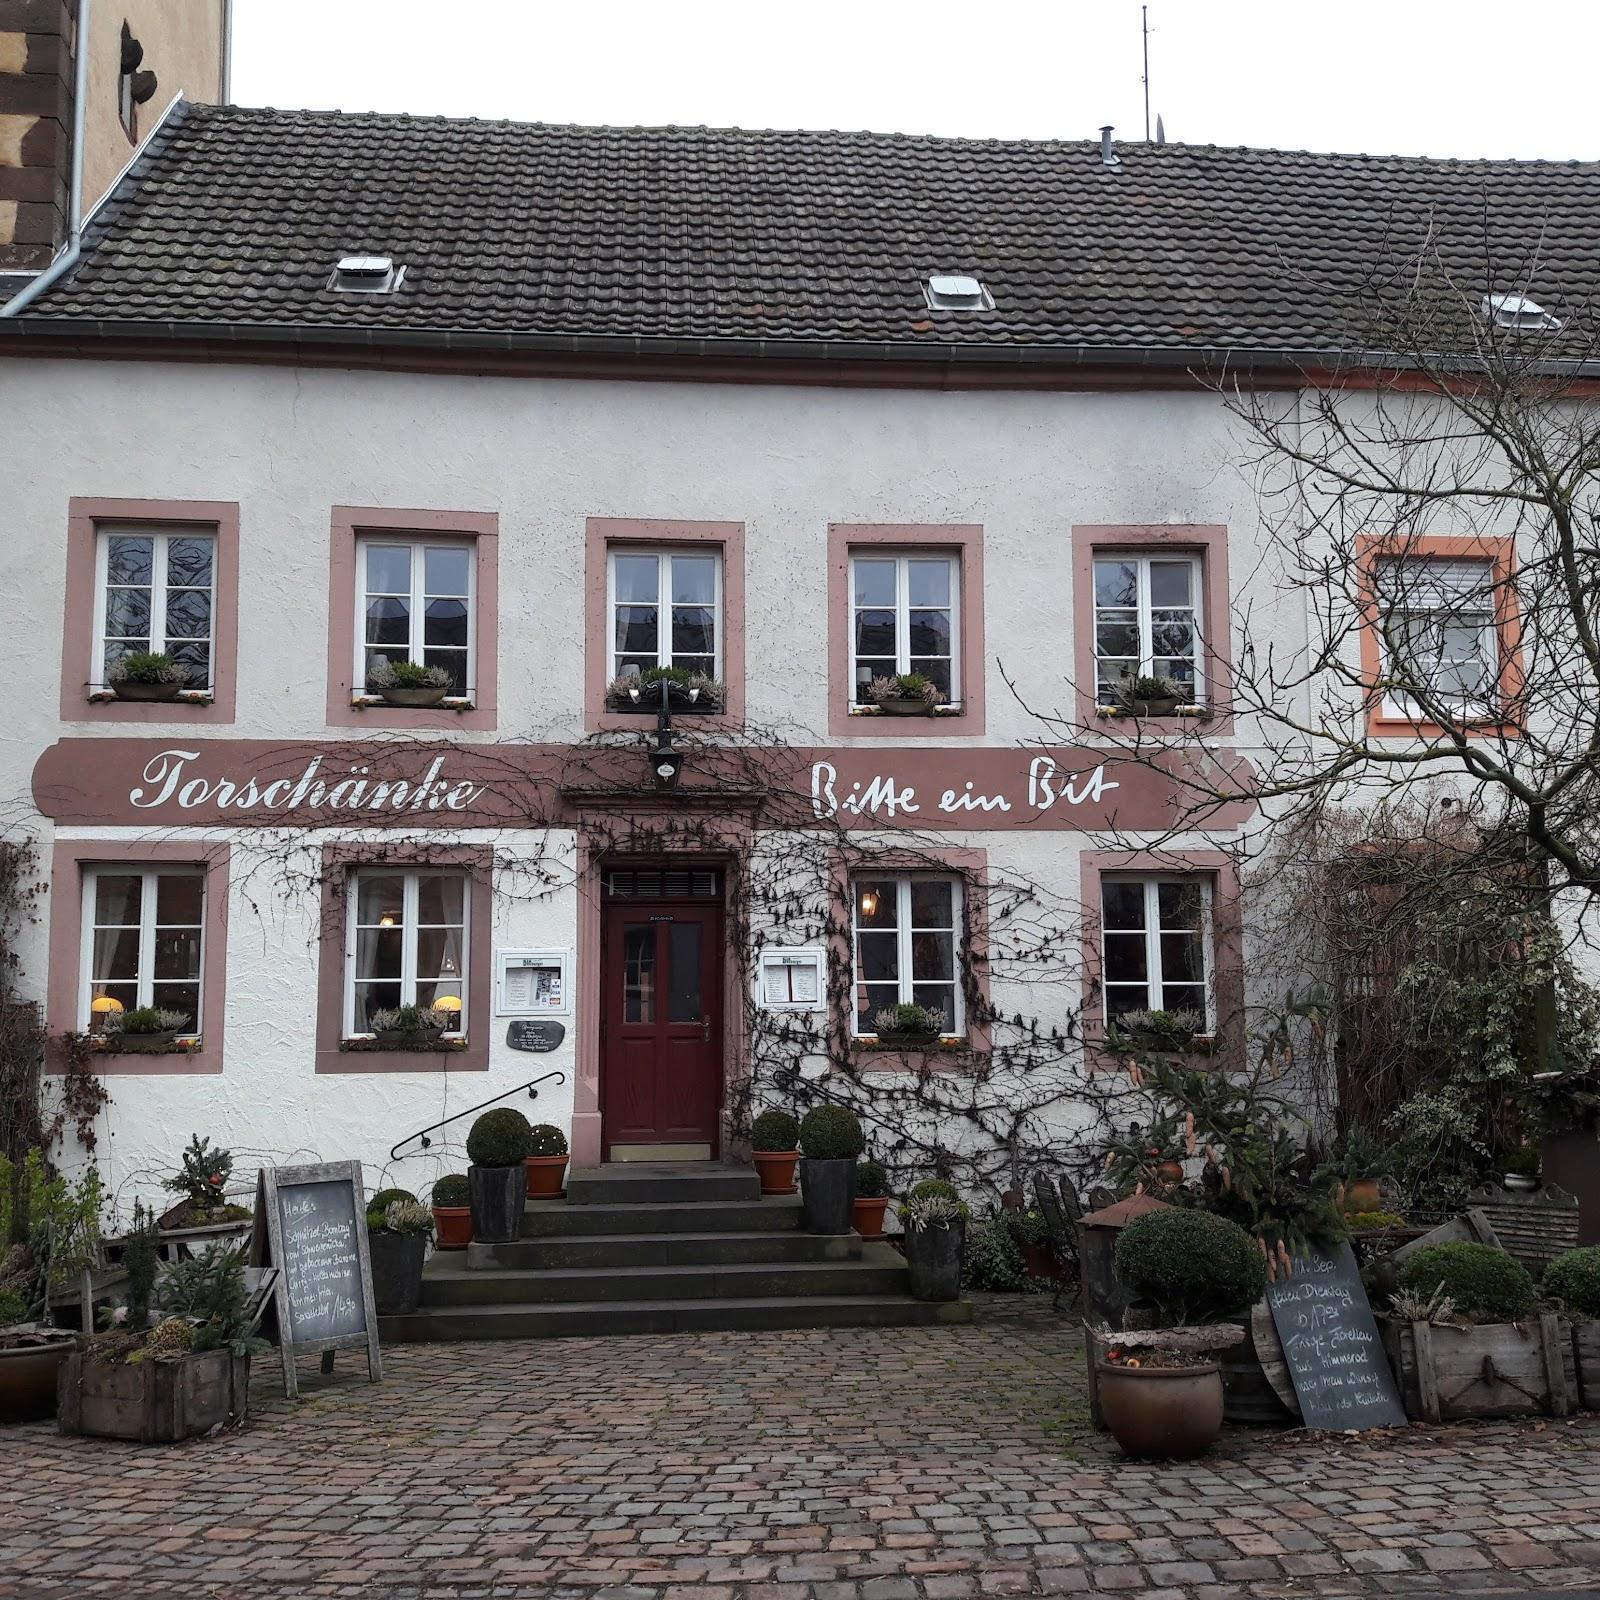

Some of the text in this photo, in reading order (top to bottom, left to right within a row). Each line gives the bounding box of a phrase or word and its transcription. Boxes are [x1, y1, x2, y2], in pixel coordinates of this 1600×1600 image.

[129, 749, 488, 810] Torschänke
[811, 756, 1120, 820] Bitte ein Bit
